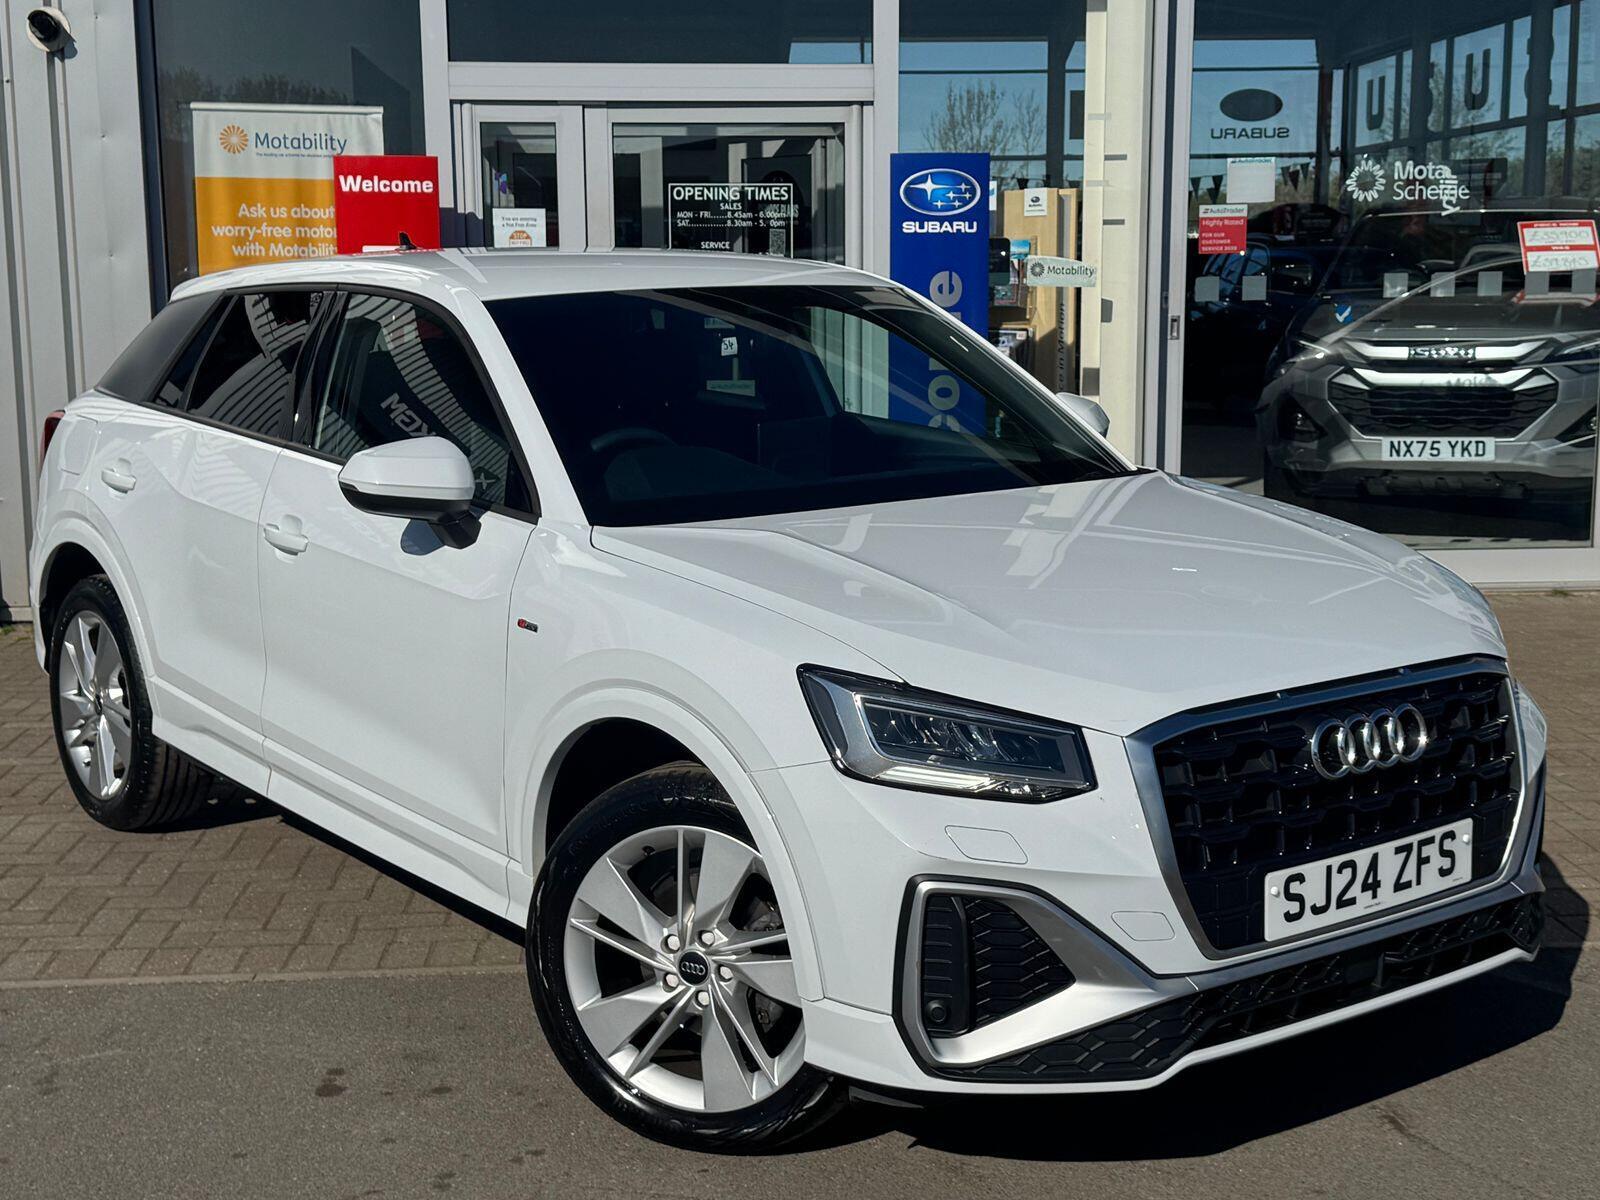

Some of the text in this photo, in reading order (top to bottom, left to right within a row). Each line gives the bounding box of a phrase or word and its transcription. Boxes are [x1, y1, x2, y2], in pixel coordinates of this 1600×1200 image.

[254, 131, 348, 156] Motability
[339, 175, 434, 193] Welcome
[672, 186, 789, 201] OPENING TIMES
[238, 203, 336, 219] Ask us about
[720, 202, 743, 210] SALES
[677, 211, 694, 219] MON
[210, 222, 292, 241] worry-free
[902, 221, 978, 234] SUBARU
[232, 241, 266, 257] with
[701, 241, 730, 249] SERVICE
[1047, 265, 1095, 278] Motability
[1389, 440, 1486, 458] NX75 YKD
[1282, 829, 1457, 924] SJ24 ZFS
